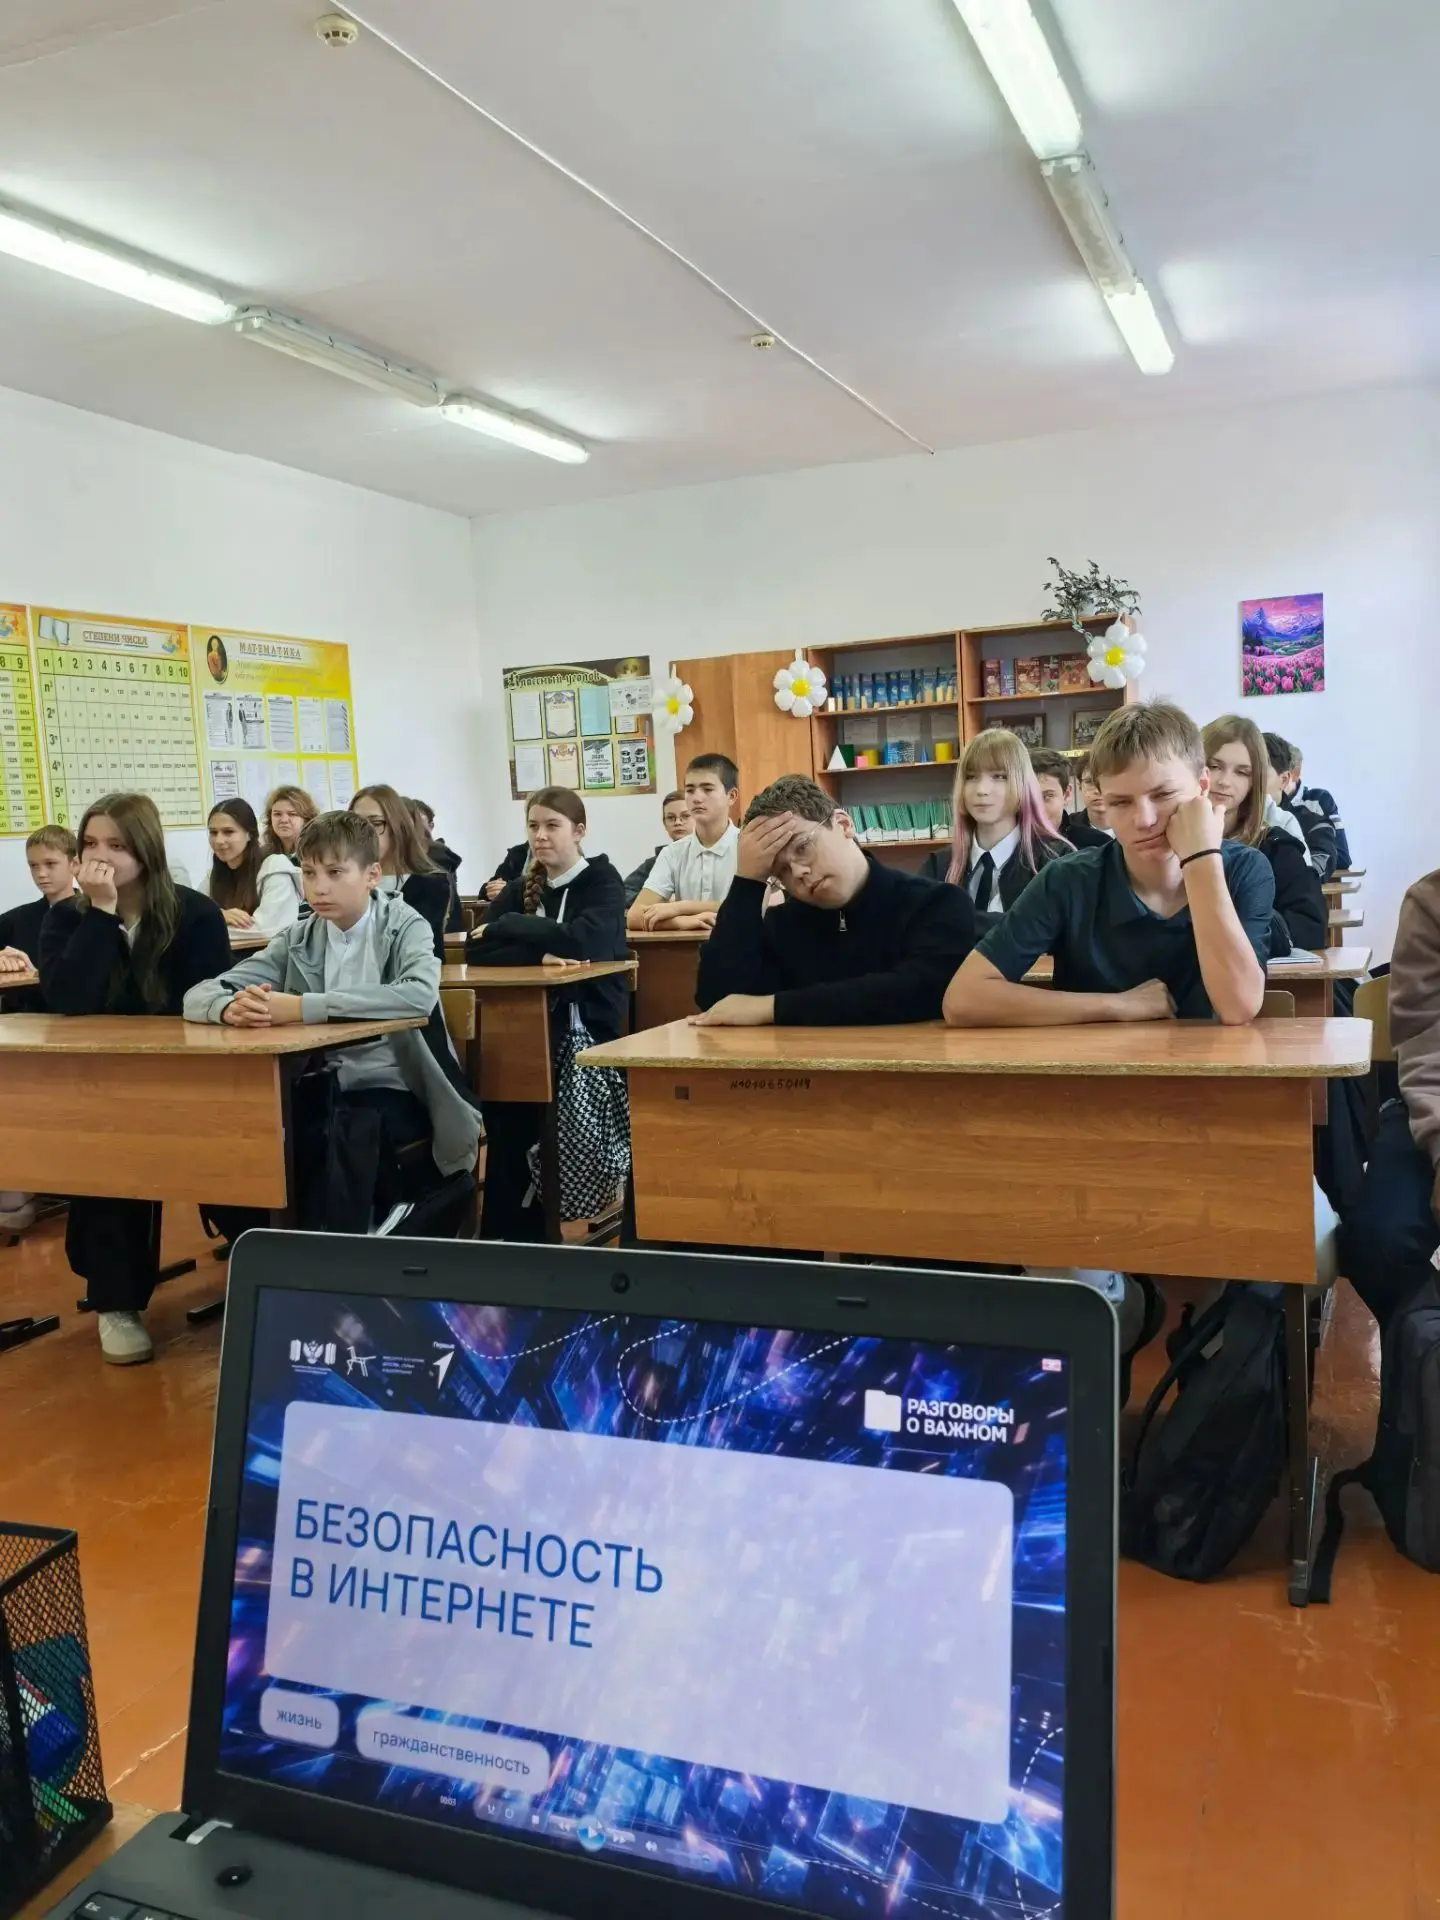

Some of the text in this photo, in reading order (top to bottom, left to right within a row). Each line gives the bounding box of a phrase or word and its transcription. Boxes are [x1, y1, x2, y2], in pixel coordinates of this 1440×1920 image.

[239, 642, 301, 656] МАТЕМАТИКА
[17, 657, 23, 669] 9
[72, 658, 78, 669] 2
[87, 659, 93, 670] 3
[101, 660, 107, 671] 4
[116, 662, 121, 672] 5
[129, 663, 135, 673] 6
[142, 664, 148, 674] 7
[155, 665, 161, 675] 8
[168, 666, 174, 676] 9
[179, 667, 188, 677] 10
[907, 1398, 1014, 1425] РАЗГОВОРЫ
[906, 1417, 1007, 1443] О ВАЖНОМ
[295, 1497, 664, 1594] БЕЗОПАСНОСТЬ
[290, 1557, 596, 1649] В ИНТЕРНЕТЕ
[276, 1708, 322, 1731] жизнь
[372, 1729, 530, 1776] гражданственность
